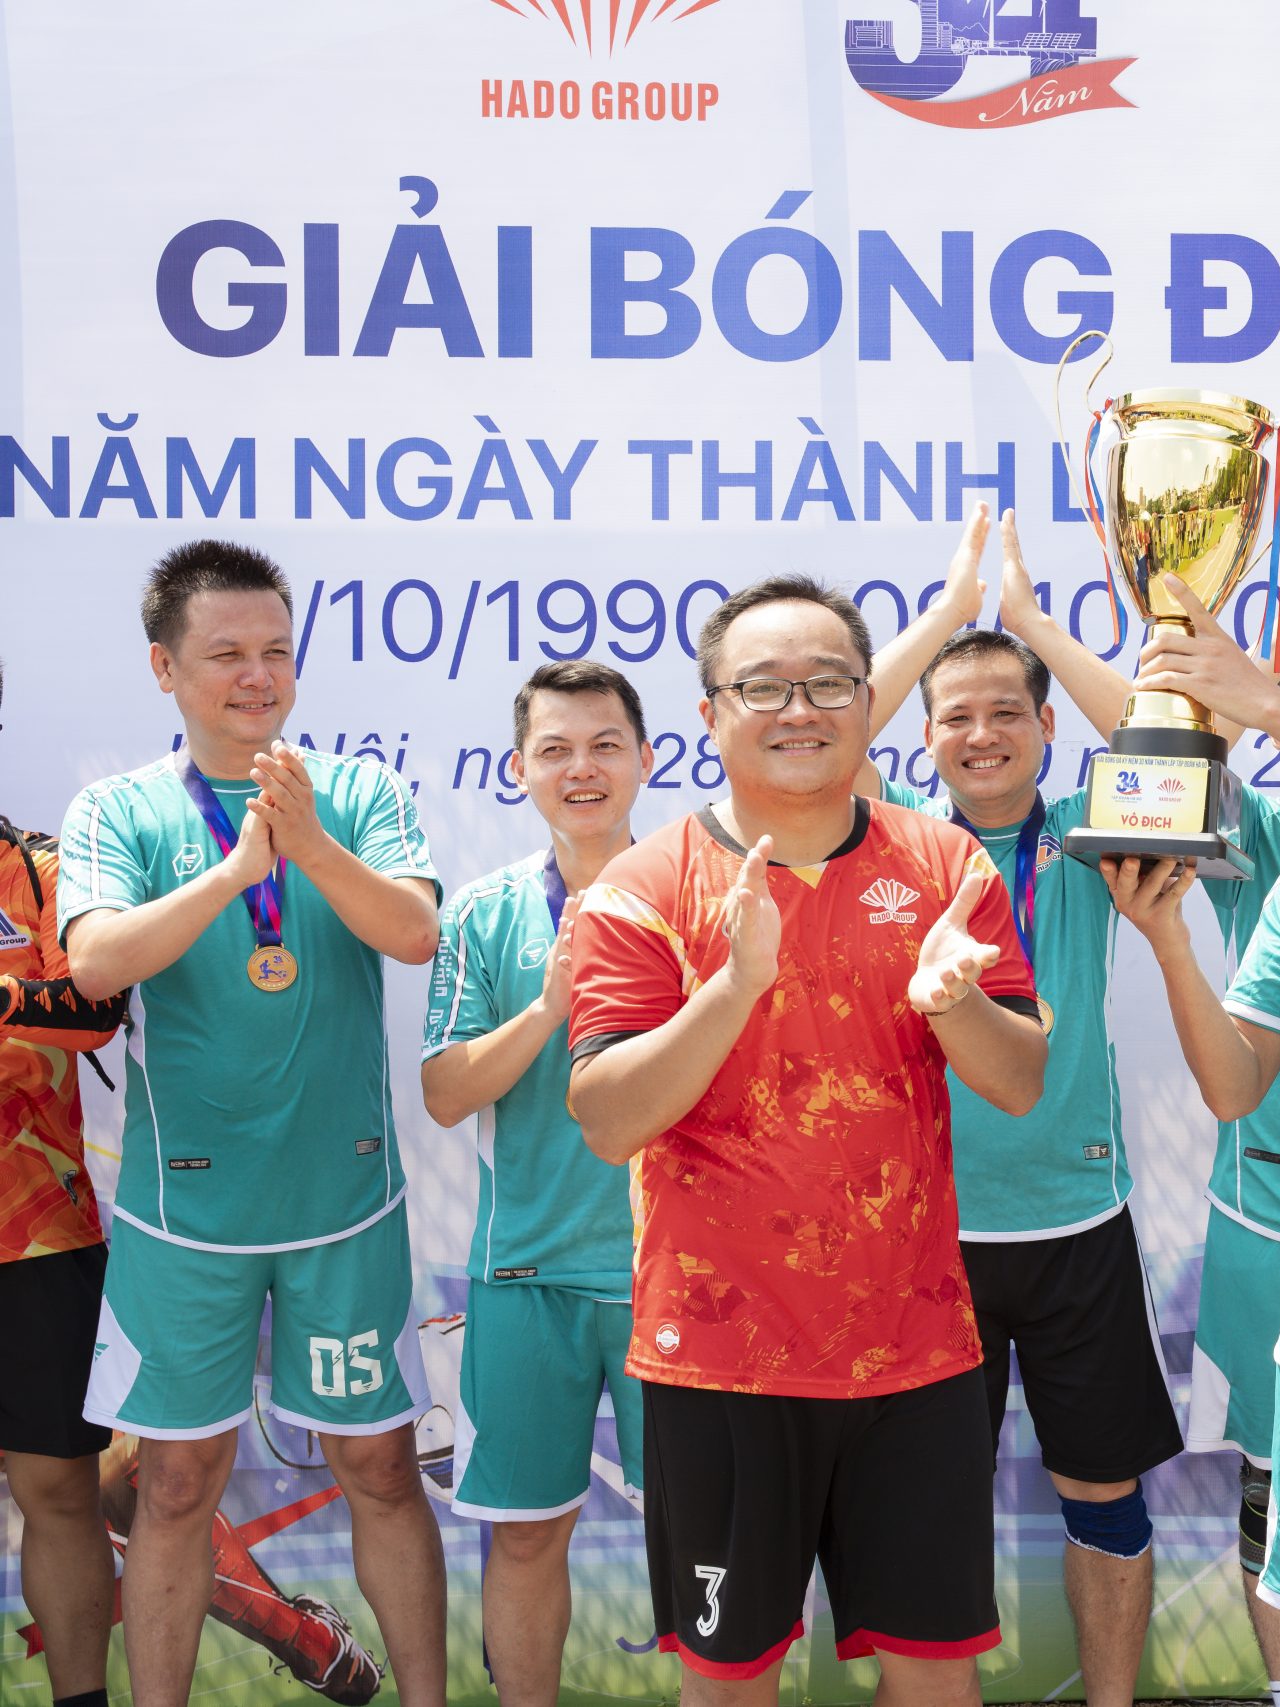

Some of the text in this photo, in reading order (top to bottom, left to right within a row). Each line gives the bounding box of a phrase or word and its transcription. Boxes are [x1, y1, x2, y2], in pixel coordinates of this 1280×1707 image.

[481, 79, 719, 121] HADO GROUP
[978, 79, 1093, 122] Năm
[156, 175, 533, 359] GIẢI
[590, 190, 1115, 364] BÓNG
[0, 412, 256, 520] NĂM
[293, 415, 599, 521] NGÀY
[627, 417, 1017, 522] THÀNH
[646, 731, 728, 790] 28
[1115, 771, 1140, 794] 34
[1121, 812, 1172, 831] VÔ ĐỊCH
[870, 911, 917, 923] HADO GROUP
[309, 1329, 384, 1397] 05
[694, 1564, 728, 1637] 3
